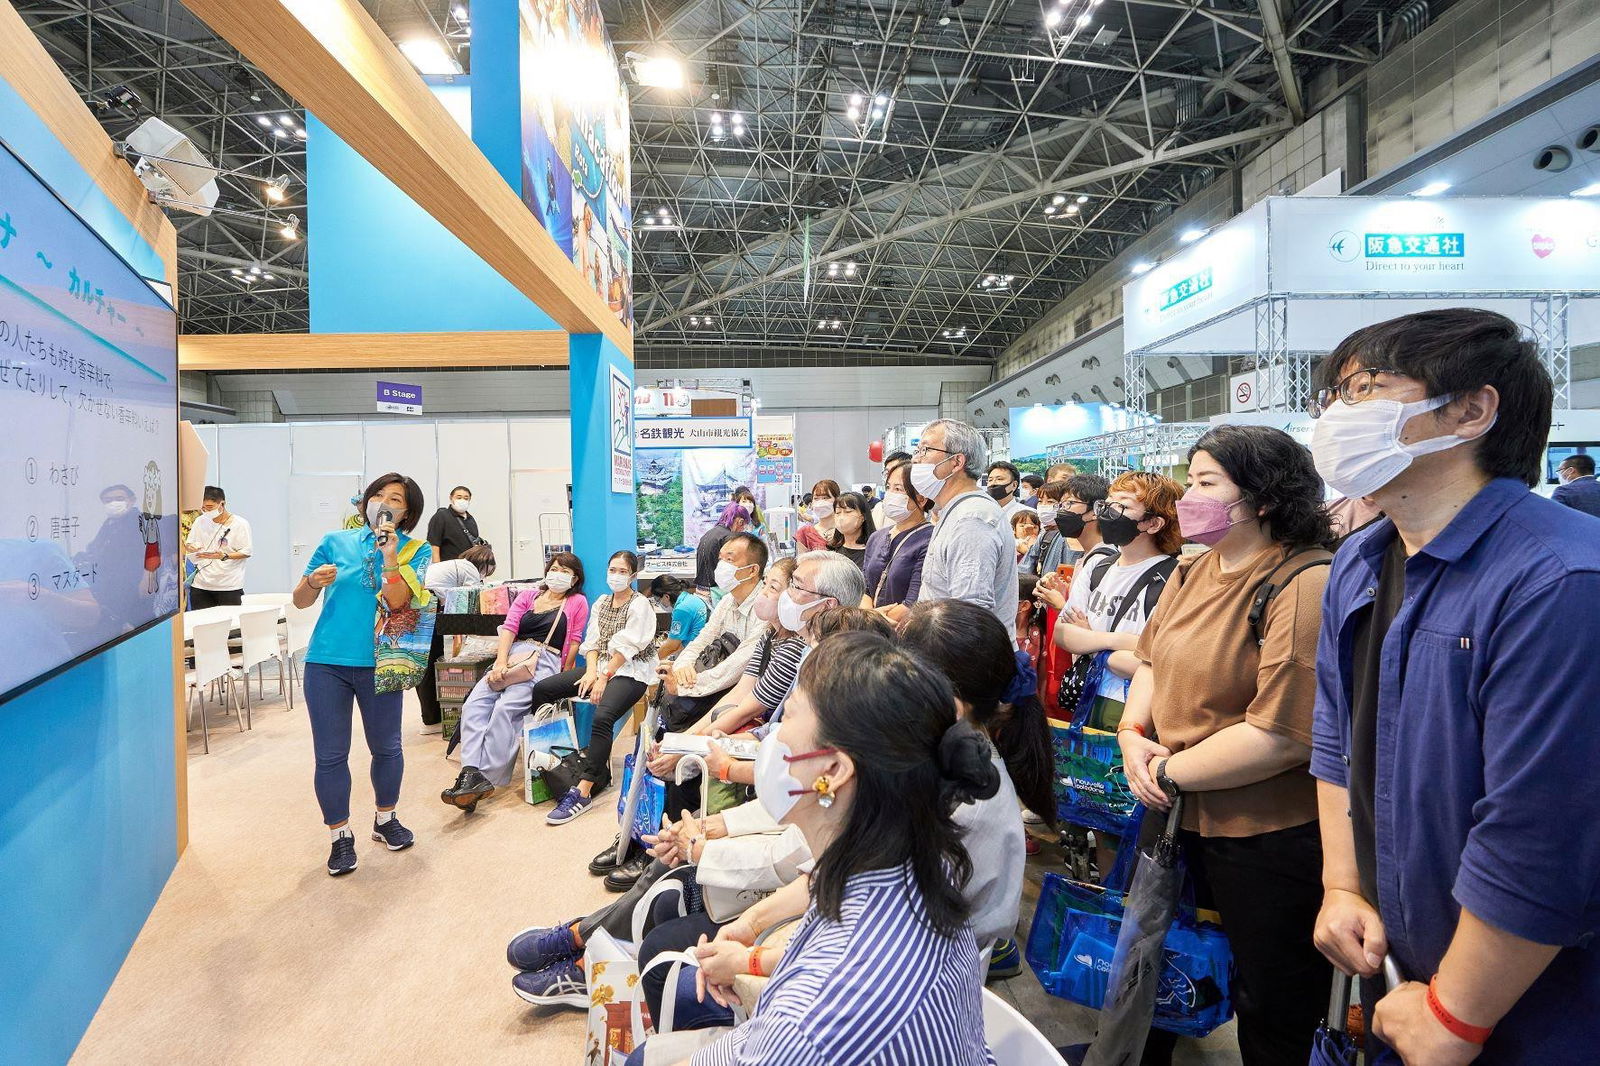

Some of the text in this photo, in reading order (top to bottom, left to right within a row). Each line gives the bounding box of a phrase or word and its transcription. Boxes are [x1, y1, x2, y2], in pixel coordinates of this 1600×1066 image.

[1368, 234, 1461, 256] 阪急交通社
[1366, 261, 1464, 273] Direct to your heart
[69, 265, 127, 326] カルチャー
[392, 389, 416, 399] Stage
[640, 427, 685, 439] 名鉄観光
[689, 428, 748, 438] 犬山市観光協会
[1283, 422, 1315, 434] Airserv
[49, 461, 80, 486] わさび
[50, 515, 80, 540] 唐辛子
[52, 562, 98, 590] マスタード
